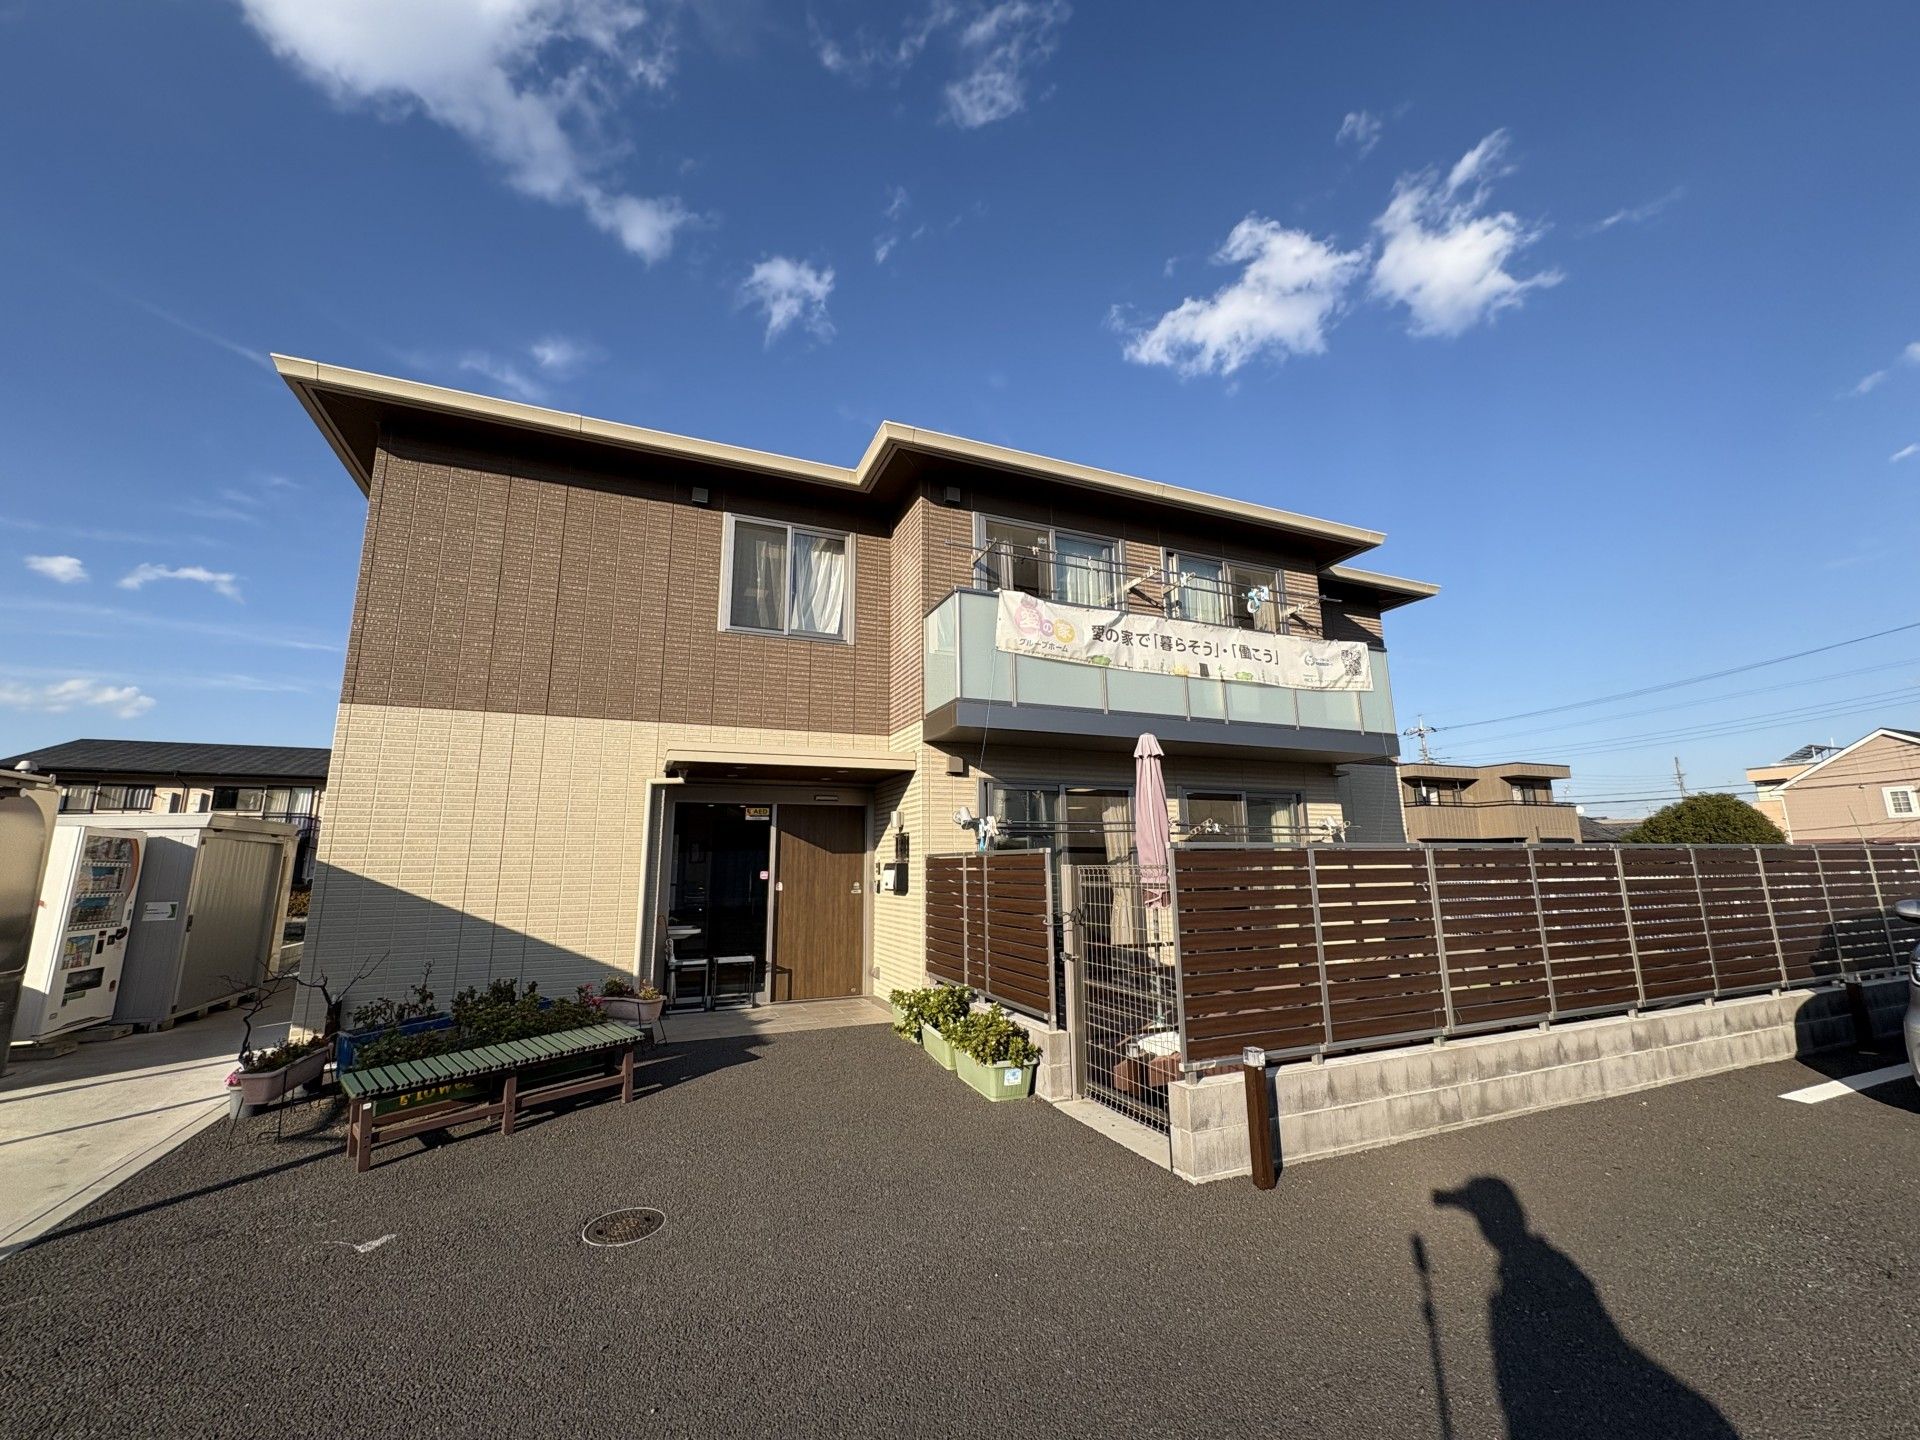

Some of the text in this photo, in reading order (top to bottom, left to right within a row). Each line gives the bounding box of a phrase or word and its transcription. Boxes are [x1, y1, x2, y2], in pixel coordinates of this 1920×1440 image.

[1019, 638, 1069, 653] グループホーム
